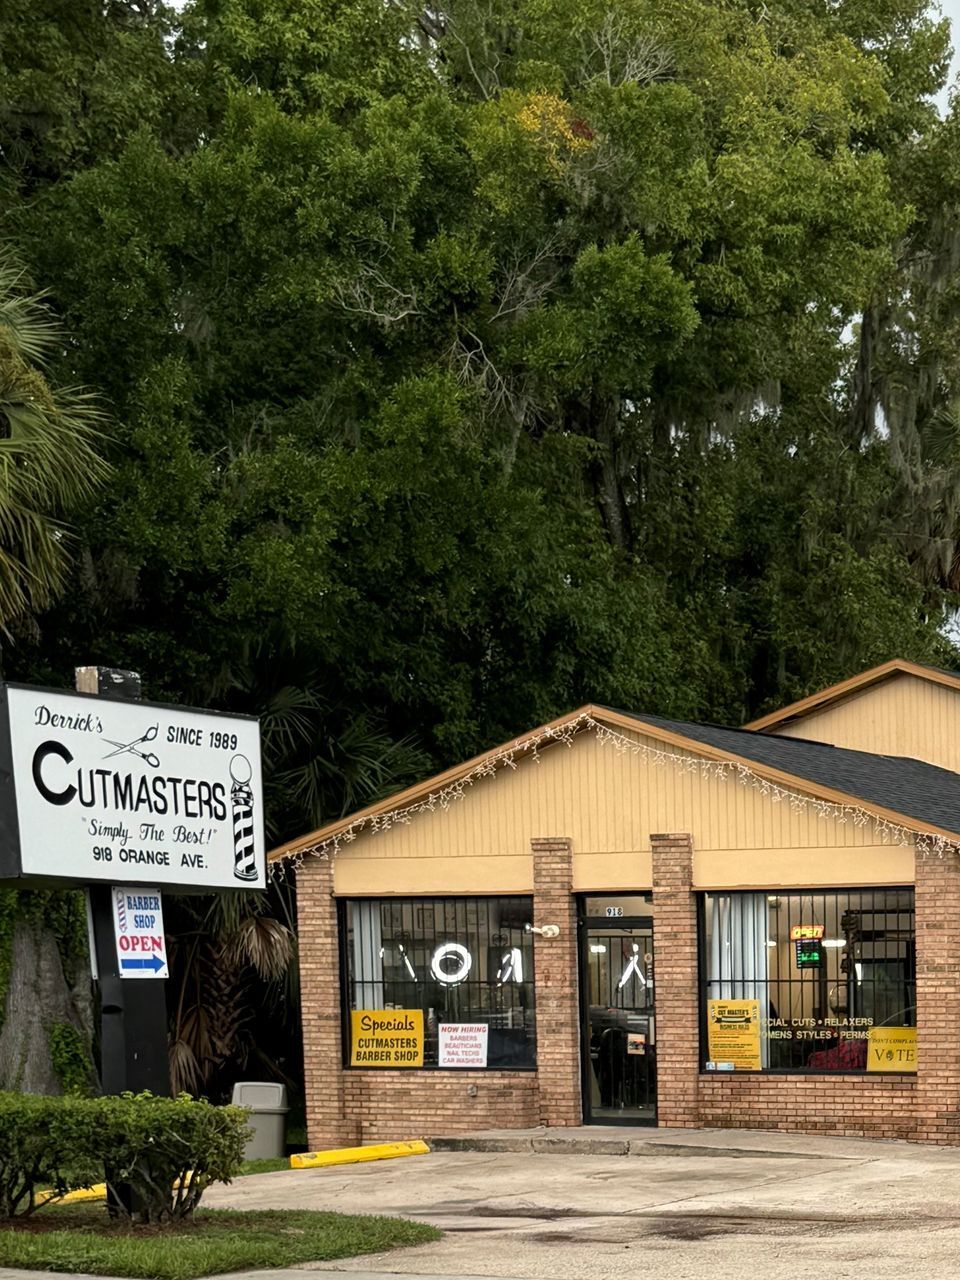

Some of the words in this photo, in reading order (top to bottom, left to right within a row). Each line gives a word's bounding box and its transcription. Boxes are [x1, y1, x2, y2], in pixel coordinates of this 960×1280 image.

[34, 704, 103, 734] Derrick's
[167, 726, 203, 746] SINCE
[209, 731, 238, 750] 1989
[32, 740, 227, 821] CUTMASTERS
[140, 823, 165, 842] The
[93, 846, 113, 862] 918
[119, 849, 170, 866] ORANGE
[180, 853, 208, 869] AVE.
[127, 896, 160, 911] BARBER
[606, 908, 623, 916] 918
[134, 914, 156, 929] SHOP
[792, 926, 824, 938] OPEN
[119, 935, 163, 952] OPEN
[361, 1014, 415, 1036] Specials
[764, 1018, 789, 1027] CIAL
[791, 1018, 817, 1027] CUTS
[824, 1017, 874, 1027] RELAXERS
[761, 1031, 793, 1040] OMENS
[796, 1031, 832, 1039] STYLES
[840, 1031, 872, 1039] PERMS
[358, 1038, 418, 1049] CUTMASTERS
[356, 1051, 391, 1061] BARBER
[394, 1051, 419, 1061] SHOP
